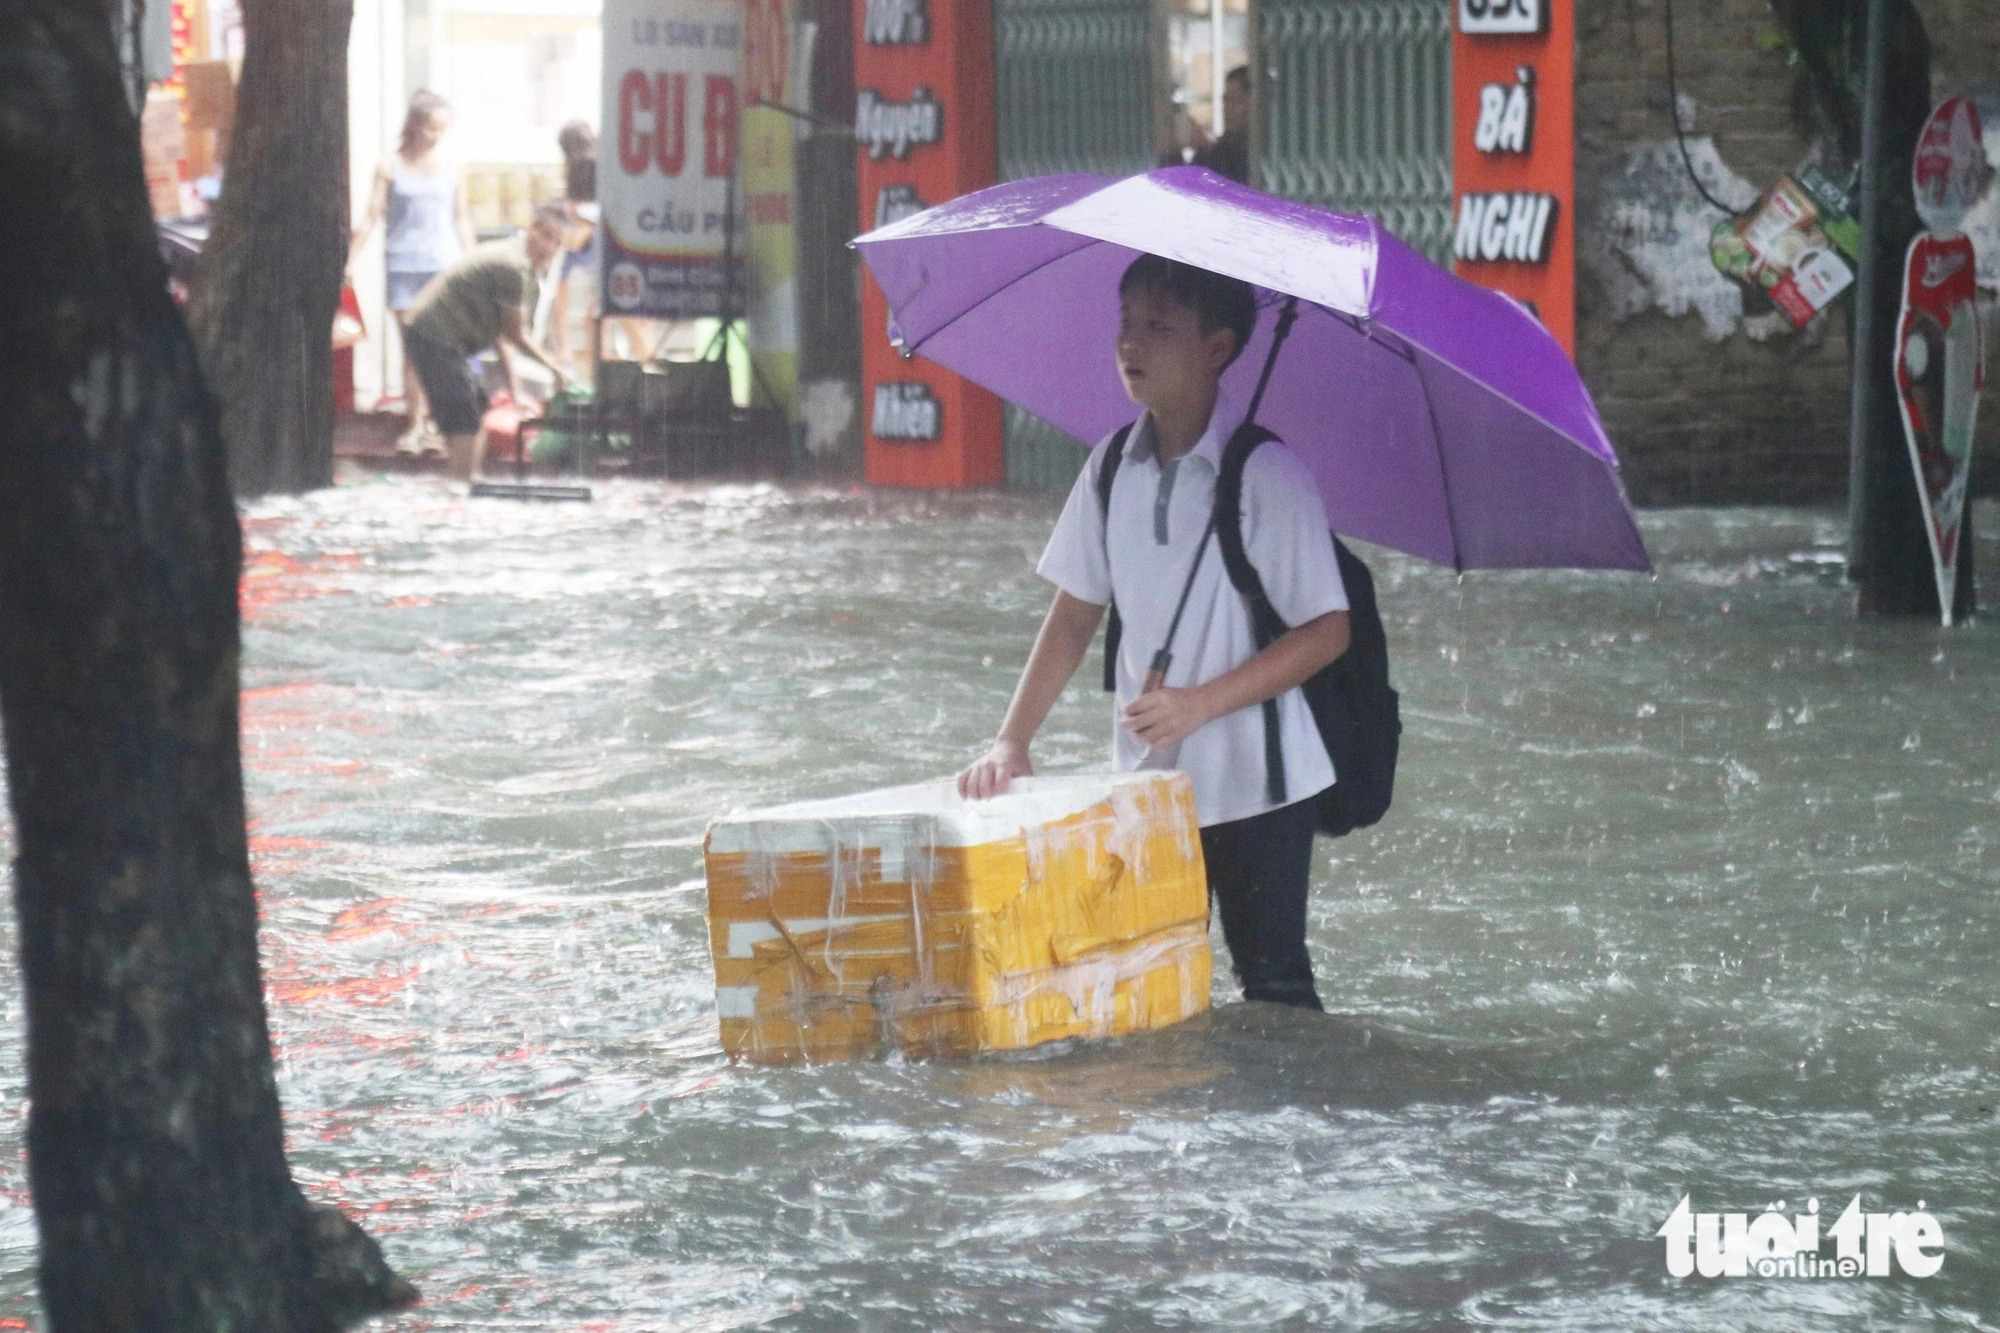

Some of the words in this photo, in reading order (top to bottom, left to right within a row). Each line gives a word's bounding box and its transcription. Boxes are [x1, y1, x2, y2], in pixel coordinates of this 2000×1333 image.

[617, 68, 687, 178] CU
[1474, 66, 1528, 152] BÀ
[1454, 192, 1551, 262] NGHI
